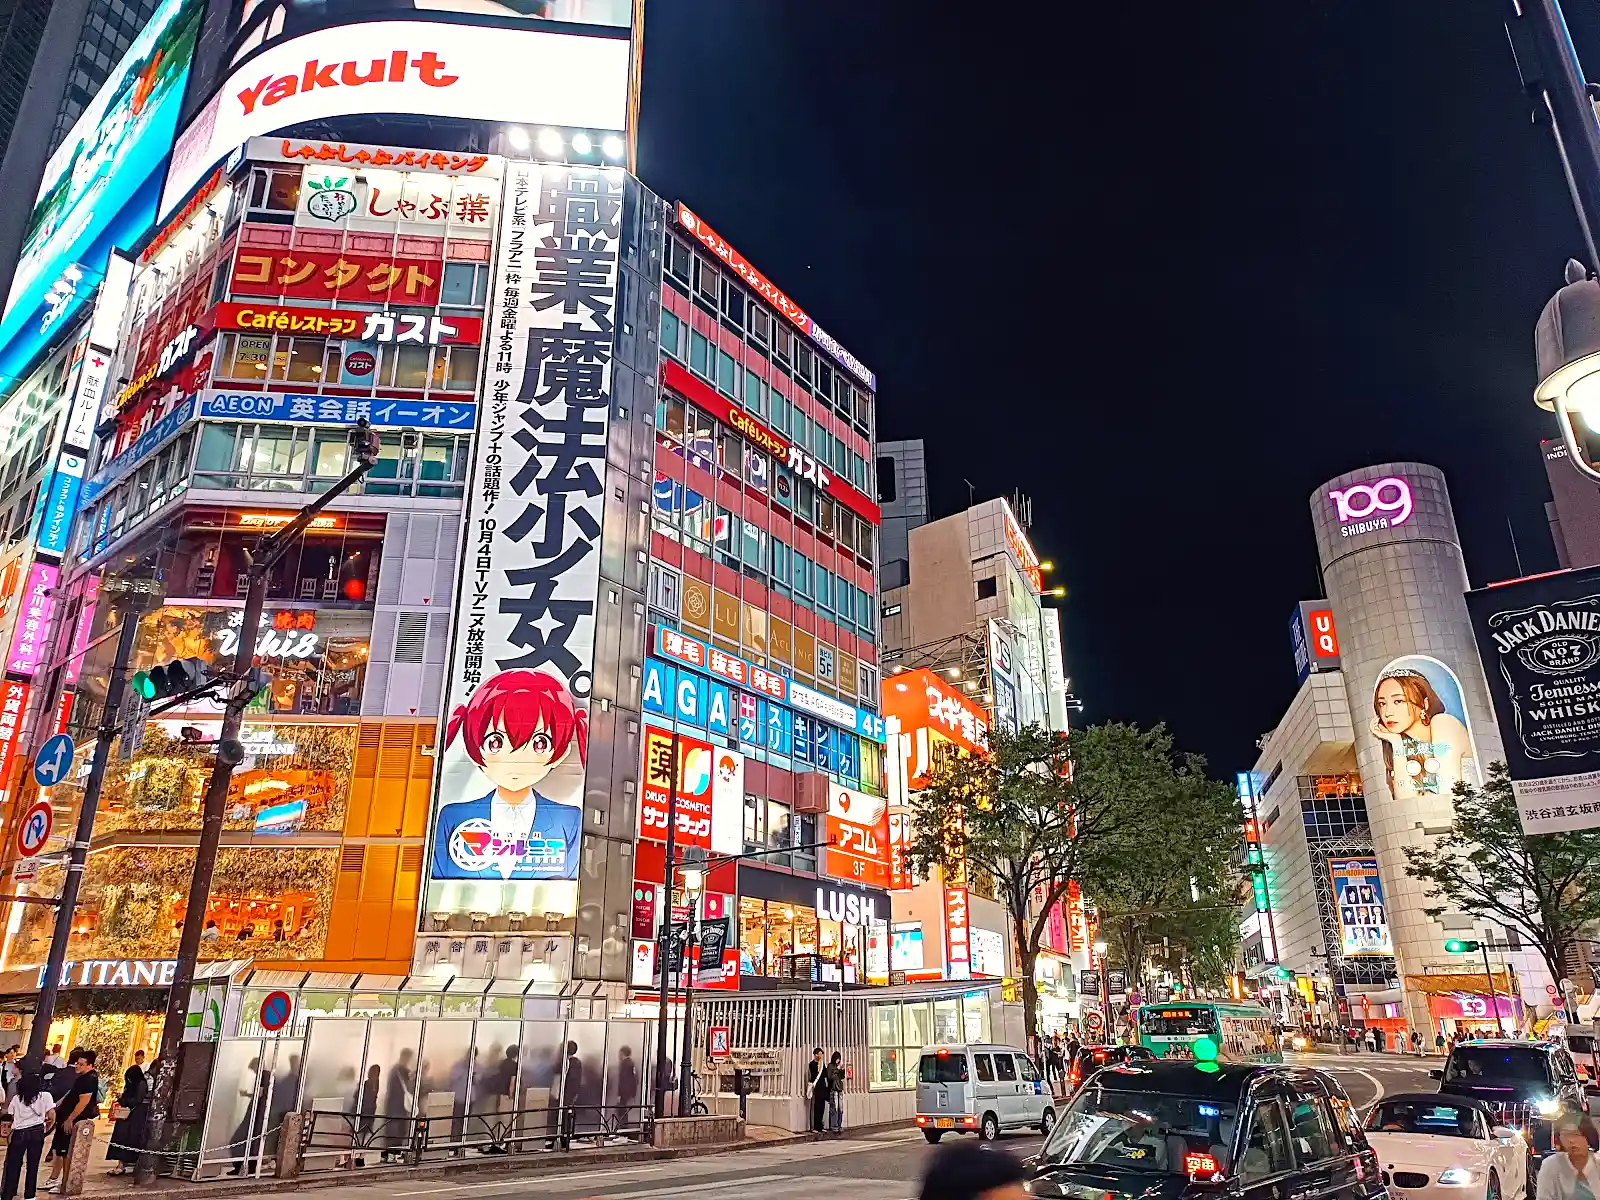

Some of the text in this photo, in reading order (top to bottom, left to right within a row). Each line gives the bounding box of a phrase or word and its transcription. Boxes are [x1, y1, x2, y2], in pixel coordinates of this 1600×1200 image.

[238, 51, 460, 117] Yakult
[281, 140, 488, 172] しゃぶしゃぶバイキング
[368, 188, 489, 223] しゃぶ葉
[236, 254, 435, 294] コンタクト
[696, 219, 809, 327] しゃぶしゃぶバイキング
[237, 309, 458, 344] Caféレストラン ガスト
[240, 339, 270, 350] OPEN
[348, 361, 373, 370] ガスト
[79, 376, 99, 435] 献血ルーム
[210, 395, 471, 425] AEON 英会話イーオン
[787, 446, 830, 490] ガスト
[1329, 476, 1413, 526] 109
[1341, 517, 1388, 537] SHIBUYA
[1491, 610, 1600, 654] JACK DANIE
[1548, 656, 1580, 666] BRAND
[1569, 644, 1581, 656] 7
[12, 661, 33, 671] 4F
[820, 657, 832, 677] 5F
[1553, 676, 1586, 686] QUALITY
[643, 668, 728, 733] AGA
[1539, 698, 1571, 708] SOUR
[862, 714, 883, 739] 4F
[1530, 730, 1553, 738] JACK
[645, 789, 711, 815] DRUG COSMETIC
[838, 823, 878, 856] アコム
[853, 861, 865, 877] 3F
[815, 887, 875, 928] LUSH
